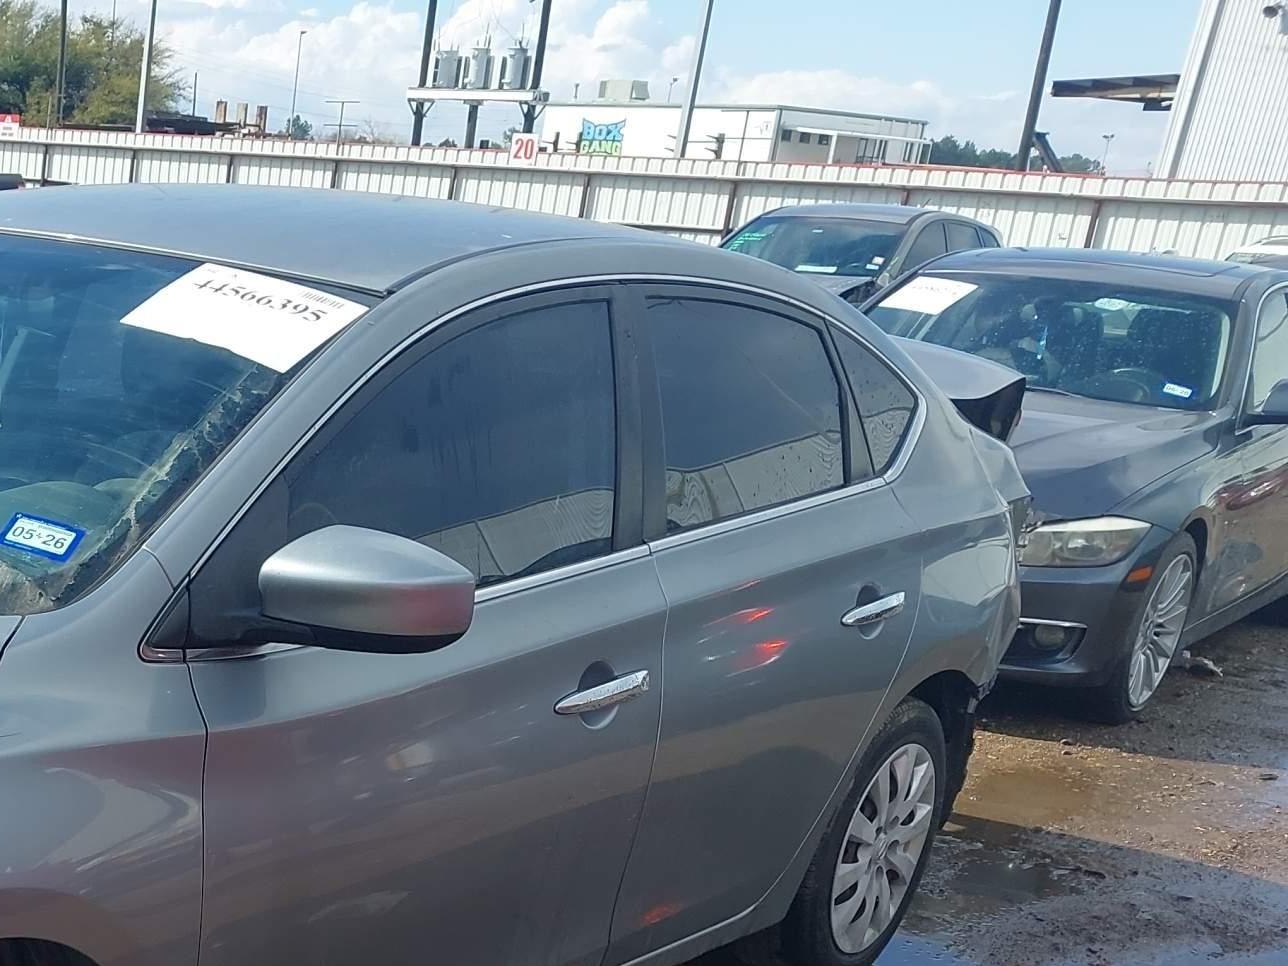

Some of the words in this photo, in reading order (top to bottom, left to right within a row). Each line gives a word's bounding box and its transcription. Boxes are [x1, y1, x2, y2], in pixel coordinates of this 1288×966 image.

[582, 117, 627, 141] BOX
[513, 138, 535, 160] 20
[579, 140, 623, 155] GANG
[192, 279, 329, 322] 44566395
